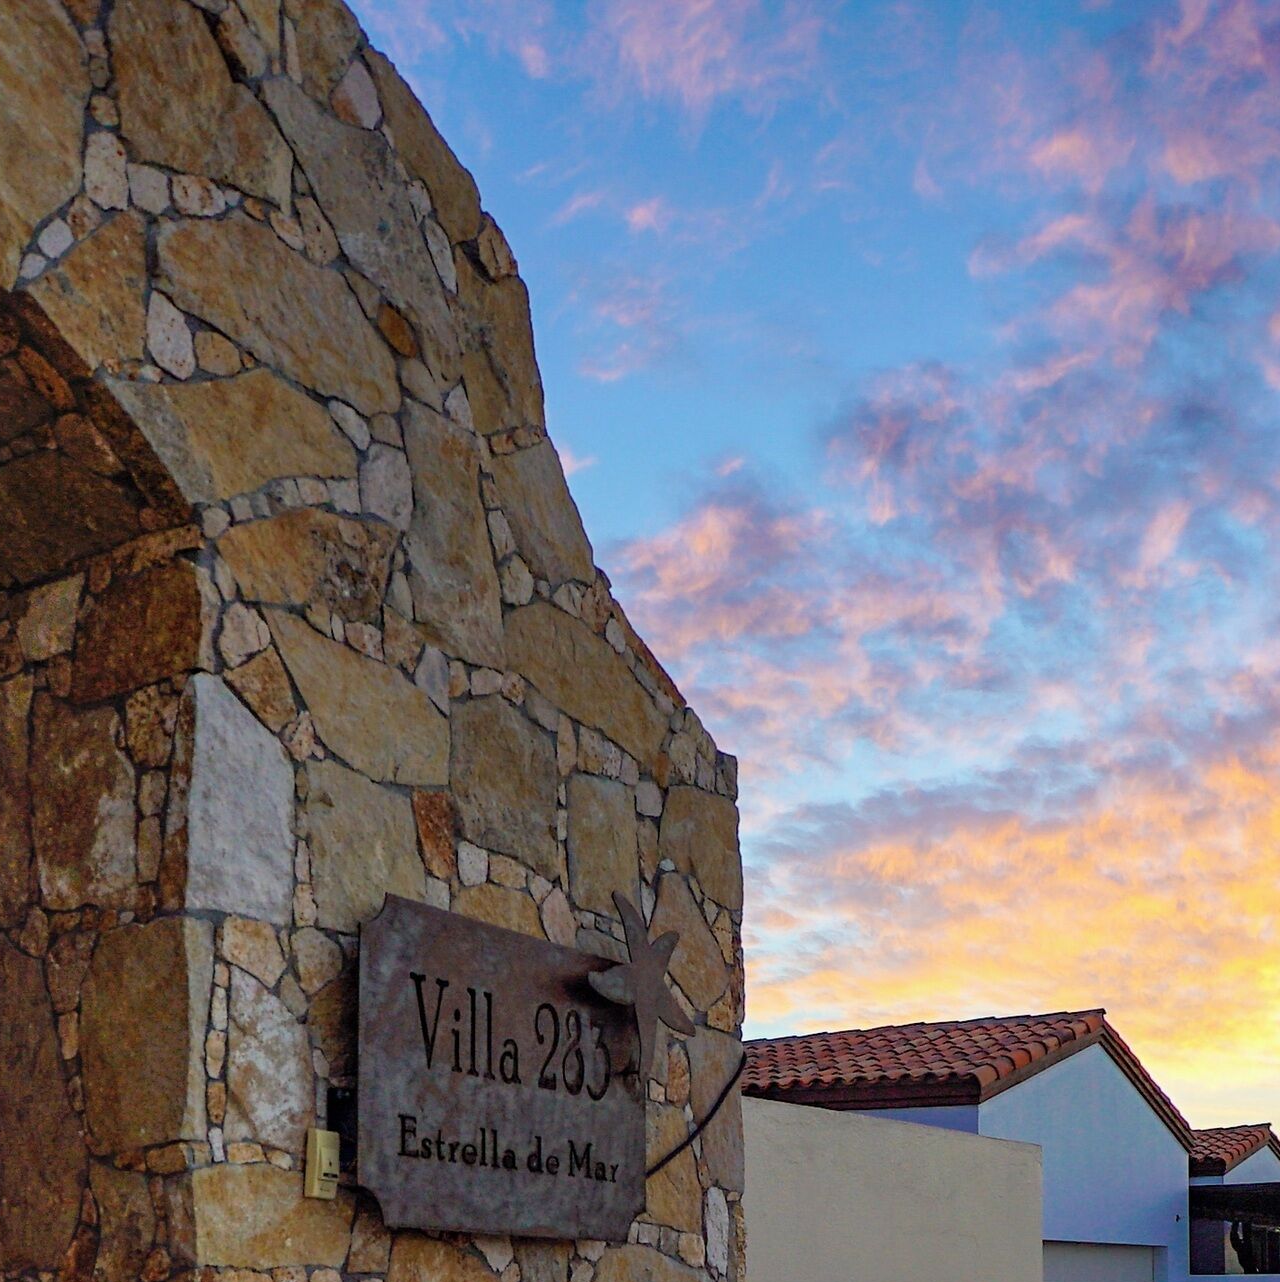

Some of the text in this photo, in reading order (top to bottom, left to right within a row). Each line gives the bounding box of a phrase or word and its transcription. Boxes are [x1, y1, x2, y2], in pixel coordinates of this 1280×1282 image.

[410, 971, 521, 1085] Villa
[397, 1113, 619, 1184] Estrella de Mar
